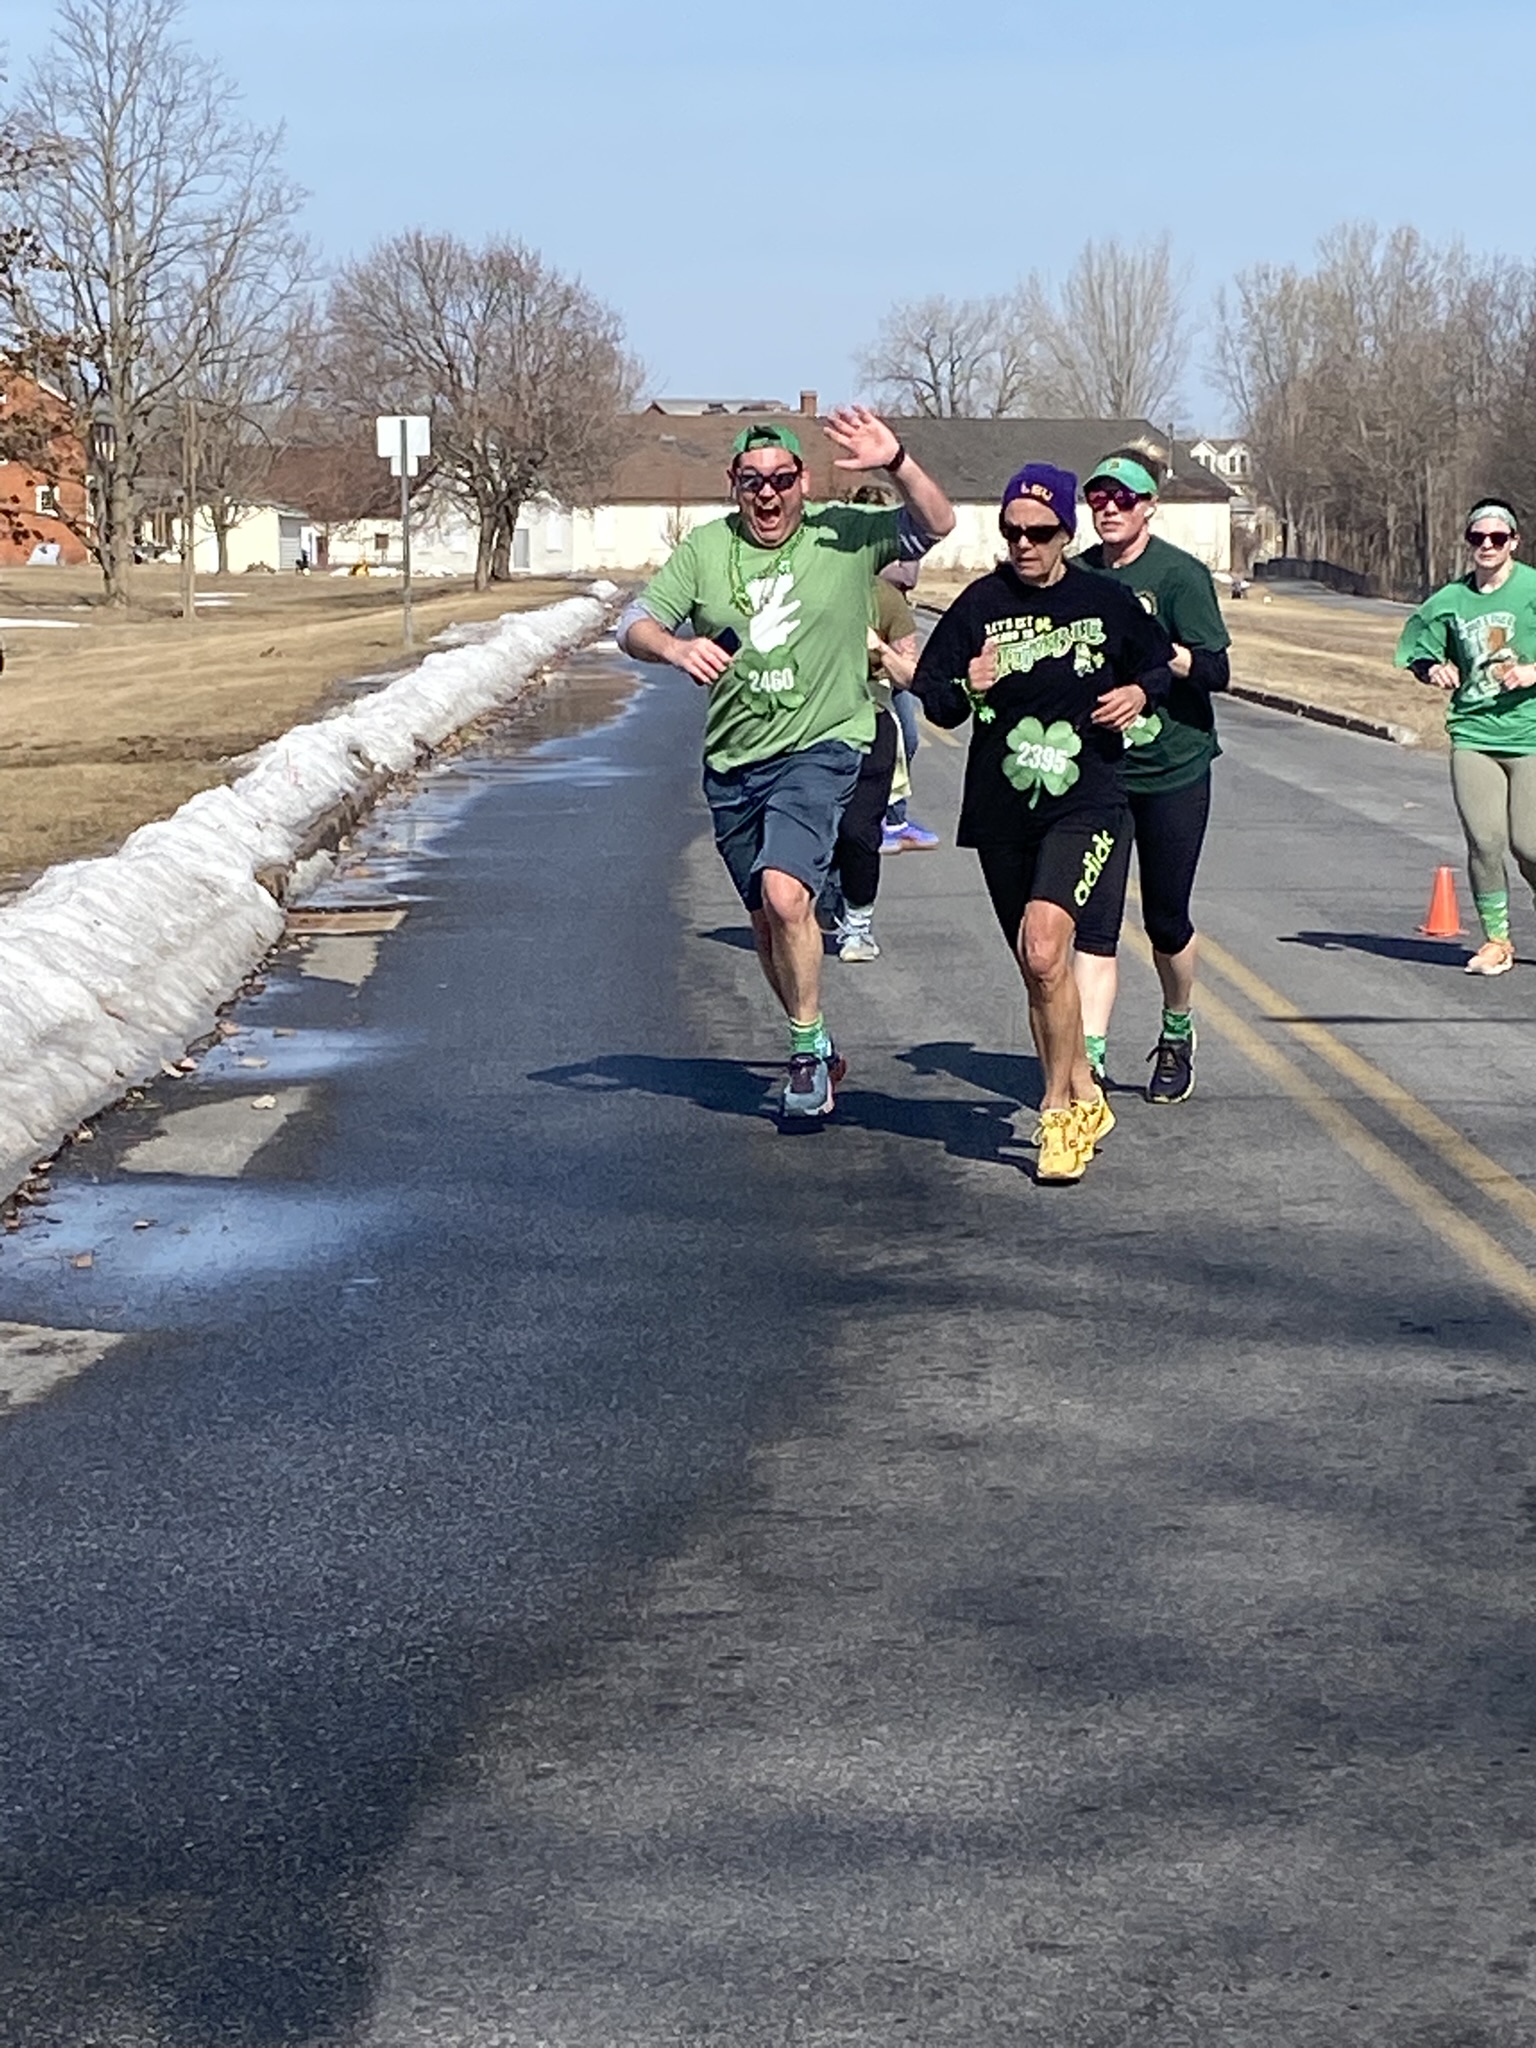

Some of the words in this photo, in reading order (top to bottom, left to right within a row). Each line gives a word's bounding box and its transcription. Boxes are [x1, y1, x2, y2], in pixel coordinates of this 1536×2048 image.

[1020, 481, 1054, 501] LSU
[748, 667, 795, 693] 2460
[1015, 741, 1069, 775] 2395
